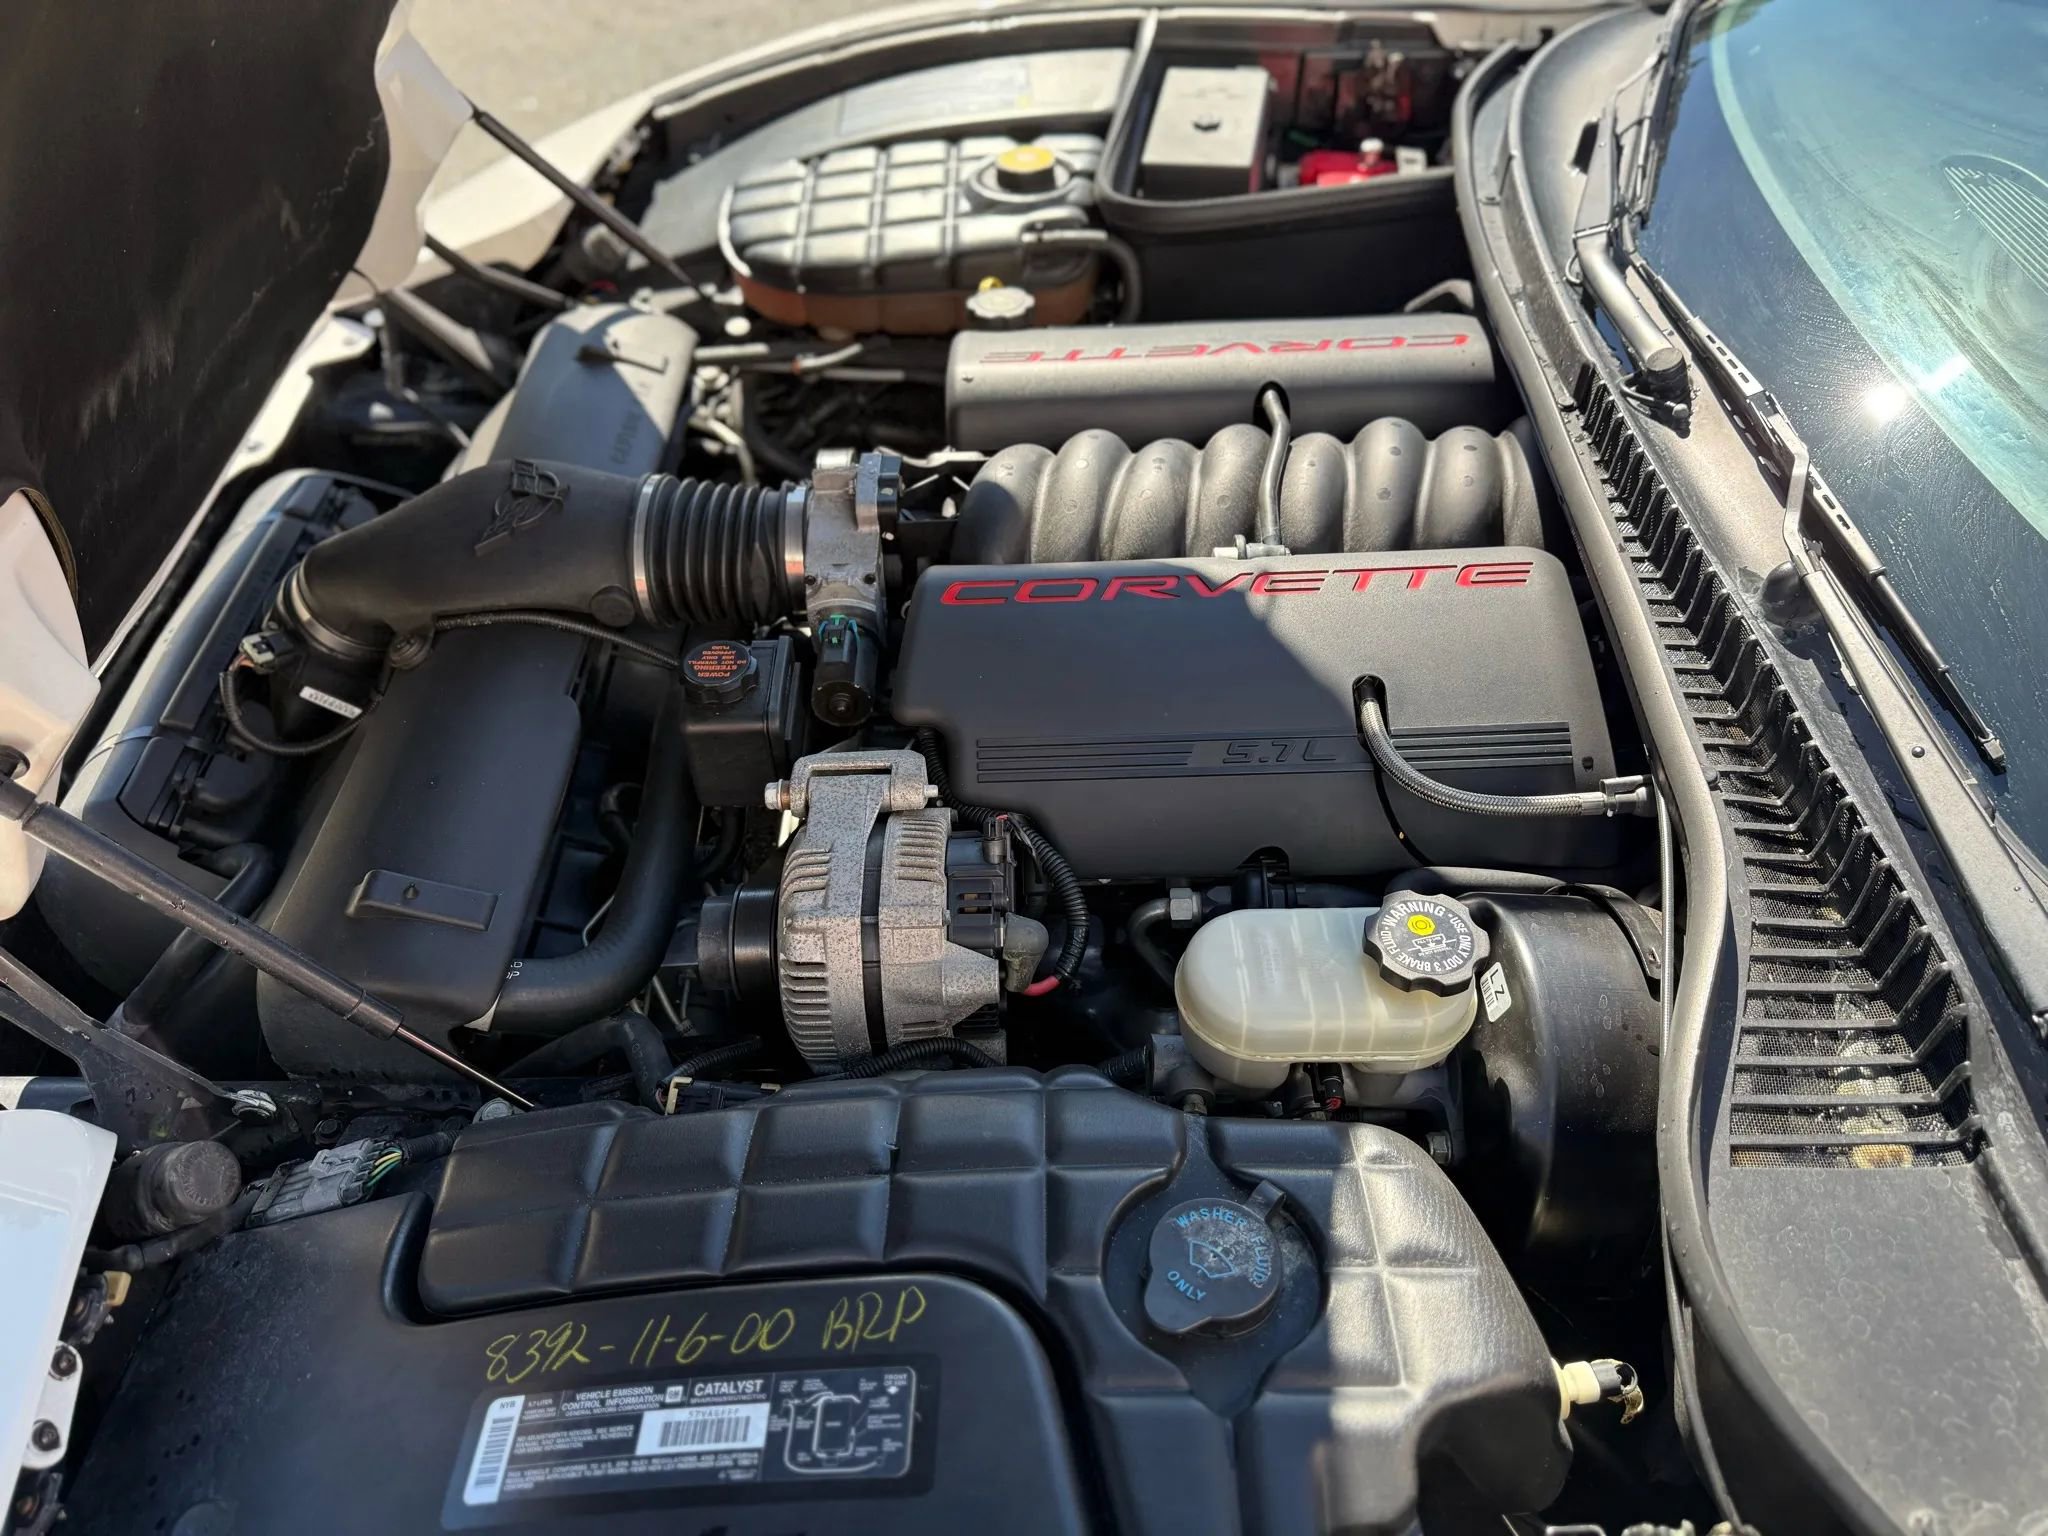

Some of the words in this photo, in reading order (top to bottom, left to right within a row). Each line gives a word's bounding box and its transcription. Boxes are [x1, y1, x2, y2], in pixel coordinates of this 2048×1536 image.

[980, 334, 1469, 363] CORVETTE
[940, 561, 1534, 605] CORVETTE
[1223, 740, 1337, 764] 5.7L
[1383, 901, 1446, 928] WARNING
[1450, 916, 1468, 934] USE
[1380, 930, 1399, 956] FLUID
[1458, 934, 1472, 959] ONLY
[1396, 953, 1432, 973] BRAKE
[1433, 961, 1442, 972] 3
[1444, 955, 1464, 971] DOT
[1175, 1207, 1248, 1229] WASHER
[1250, 1234, 1272, 1285] FLUID
[1167, 1270, 1207, 1301] ONLY
[576, 1390, 611, 1401] VEHICLE
[612, 1385, 654, 1397] EMISSION
[694, 1380, 763, 1397] CATALYST
[561, 1400, 601, 1411] CONTROL
[606, 1393, 664, 1406] INFORMATION
